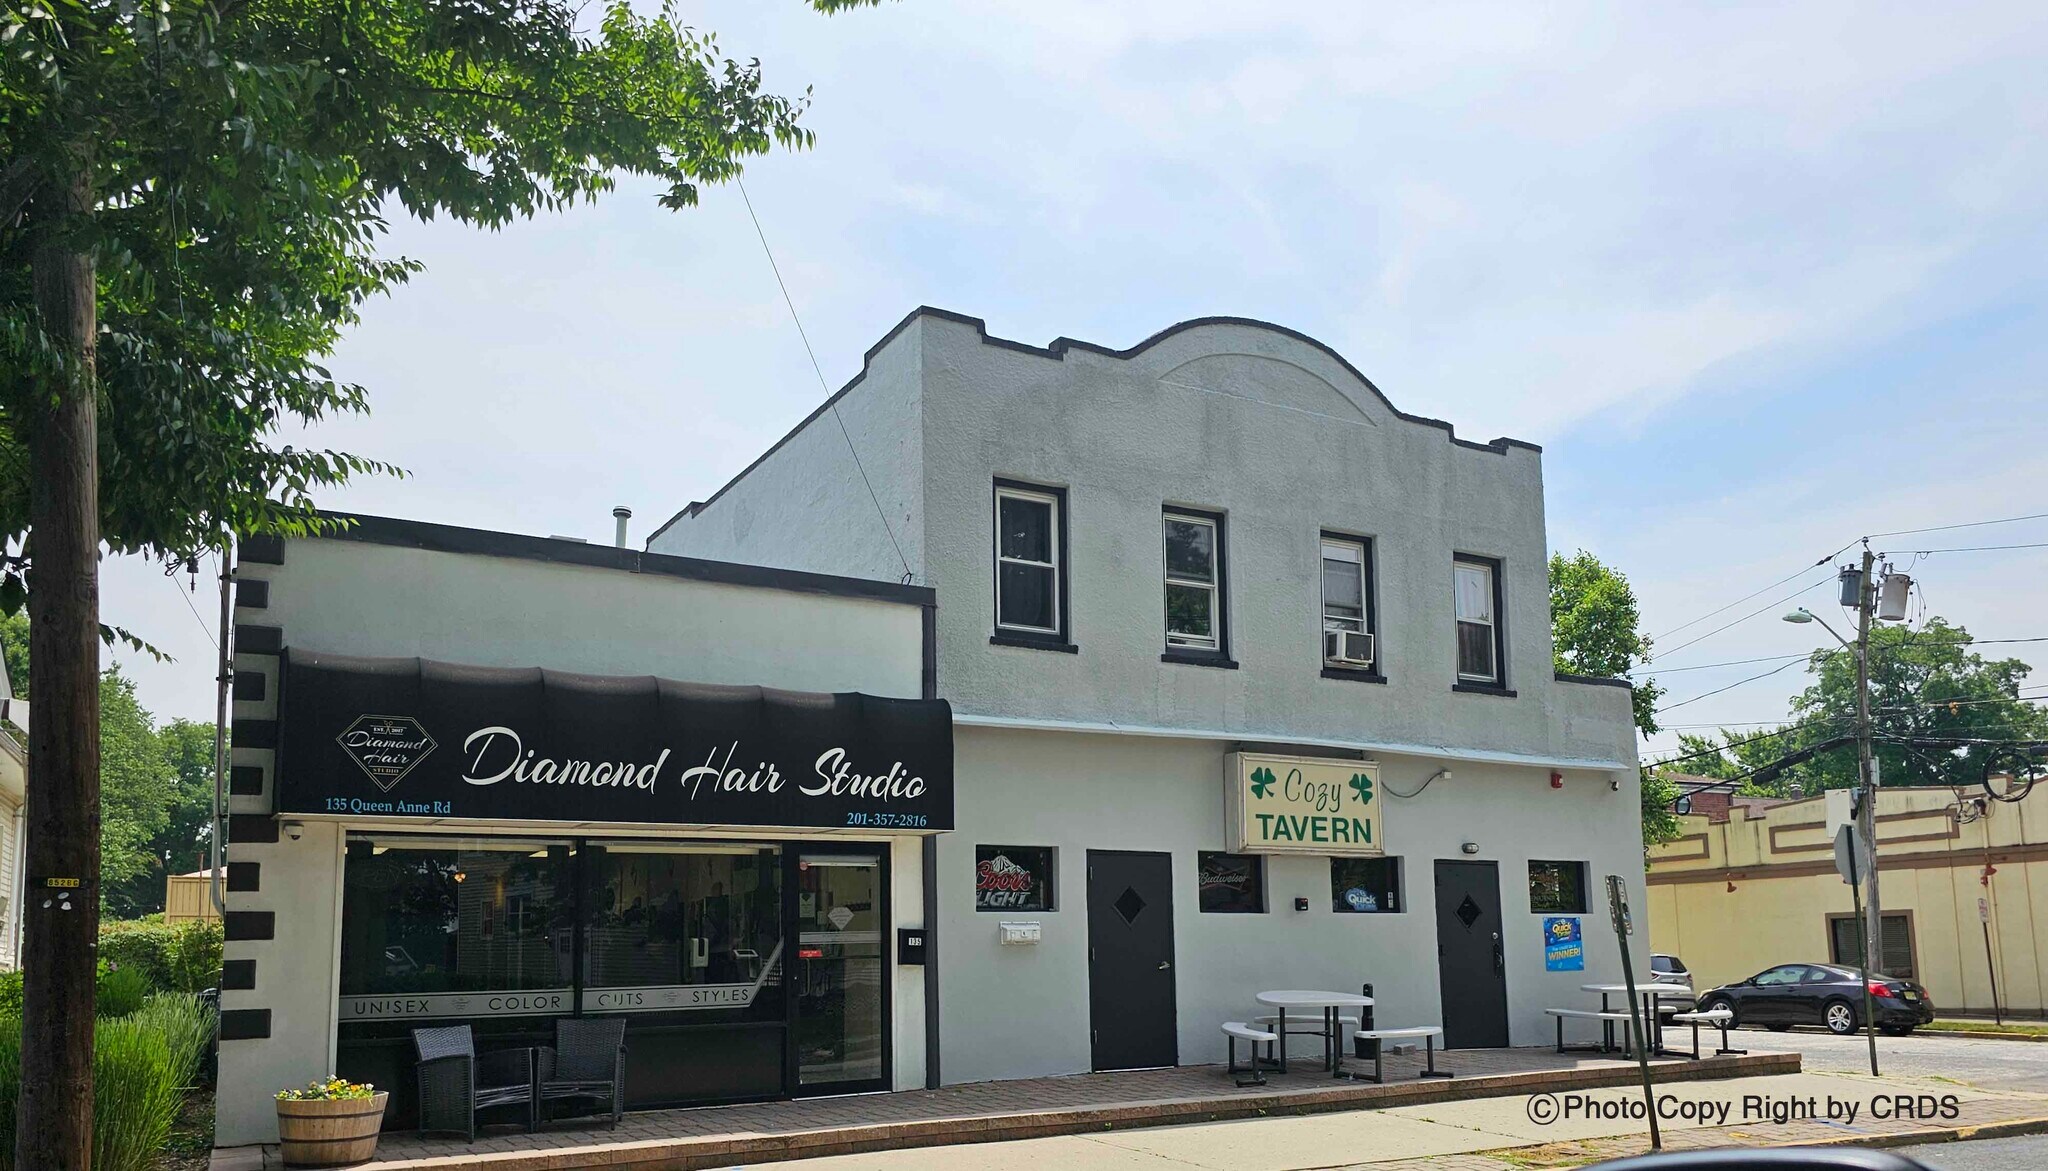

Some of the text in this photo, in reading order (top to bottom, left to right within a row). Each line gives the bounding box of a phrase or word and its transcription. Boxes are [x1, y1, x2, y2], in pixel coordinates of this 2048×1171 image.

[347, 731, 427, 750] Diamond
[363, 747, 409, 765] Hair
[462, 726, 927, 802] Diamond Hair Studio
[1285, 768, 1341, 813] Cozy
[325, 798, 451, 814] 135 Queen Anne Rd
[847, 812, 927, 827] 201-357-2816
[1255, 814, 1372, 843] TAVERN
[976, 860, 1031, 891] Coors
[976, 891, 1031, 906] LIGHT
[1348, 894, 1376, 904] Quick
[489, 995, 561, 1010] COLOR
[692, 989, 749, 1003] STYLES
[355, 1000, 429, 1014] UNISEX
